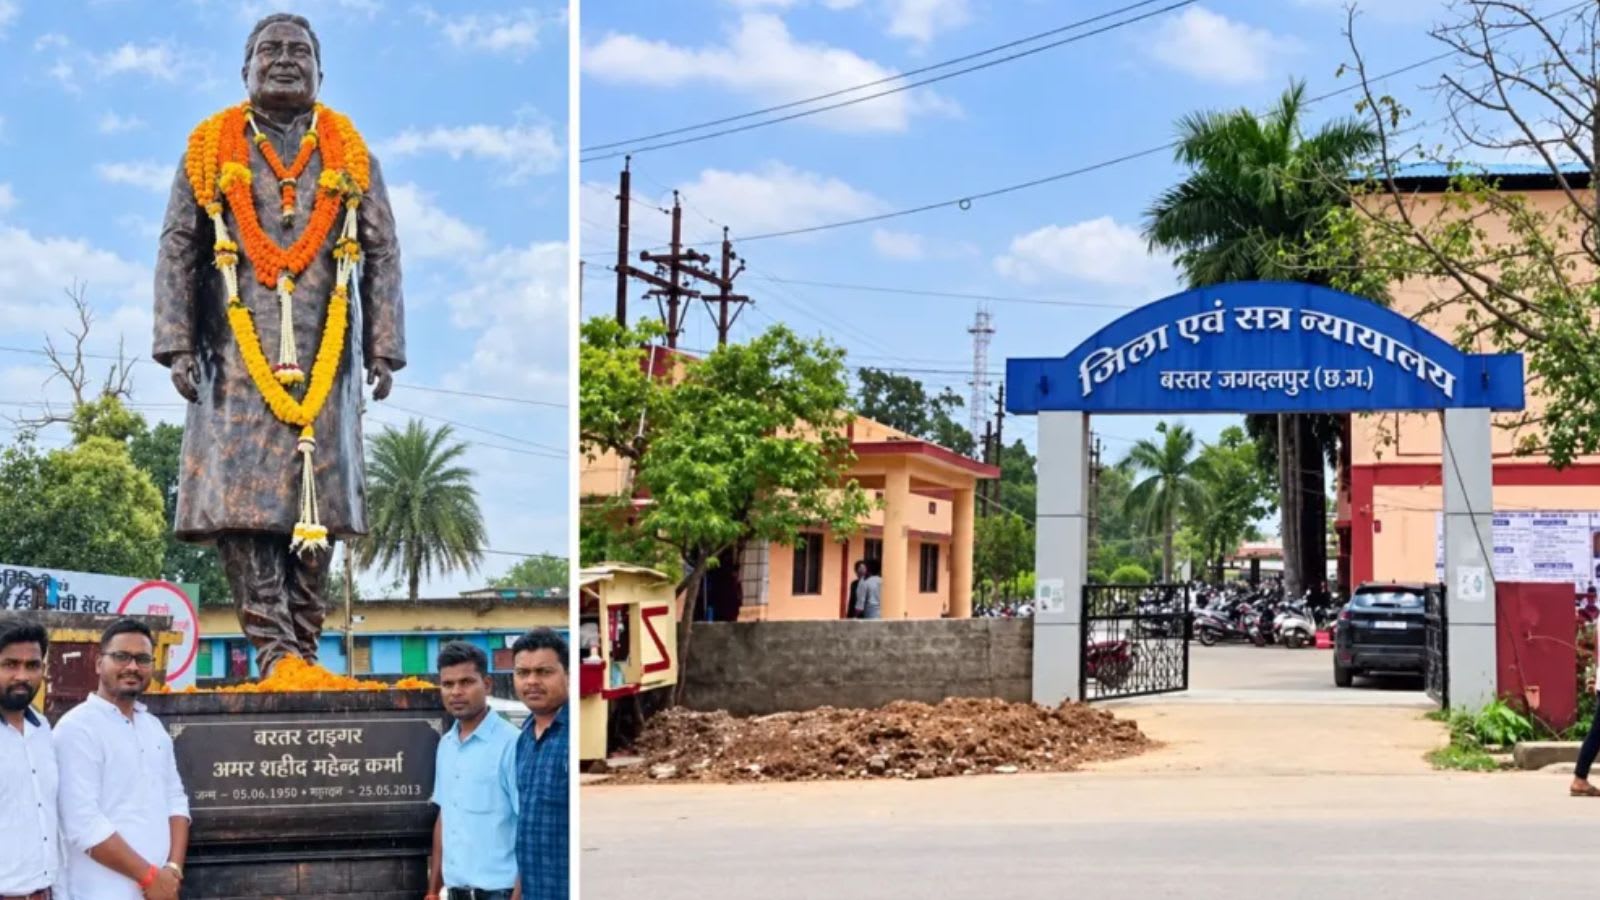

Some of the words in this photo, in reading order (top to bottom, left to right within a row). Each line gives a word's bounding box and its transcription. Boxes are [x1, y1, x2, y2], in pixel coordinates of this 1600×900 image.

[1078, 325, 1169, 398] जिला
[1175, 299, 1225, 342] एवं
[1235, 306, 1292, 331] सत्र
[1300, 308, 1457, 399] न्यायालय
[1160, 370, 1211, 390] बस्तर
[1218, 370, 1310, 397] जगदलपुर
[1315, 367, 1374, 391] (छ.ग.)
[307, 728, 364, 747] टाइगर
[212, 760, 254, 778] अमर
[260, 753, 307, 777] शहीद
[312, 752, 361, 777] महेन्द्र
[365, 751, 404, 774] कर्मा
[233, 789, 297, 800] 05.06.1950
[359, 784, 421, 797] 25.05.2013
